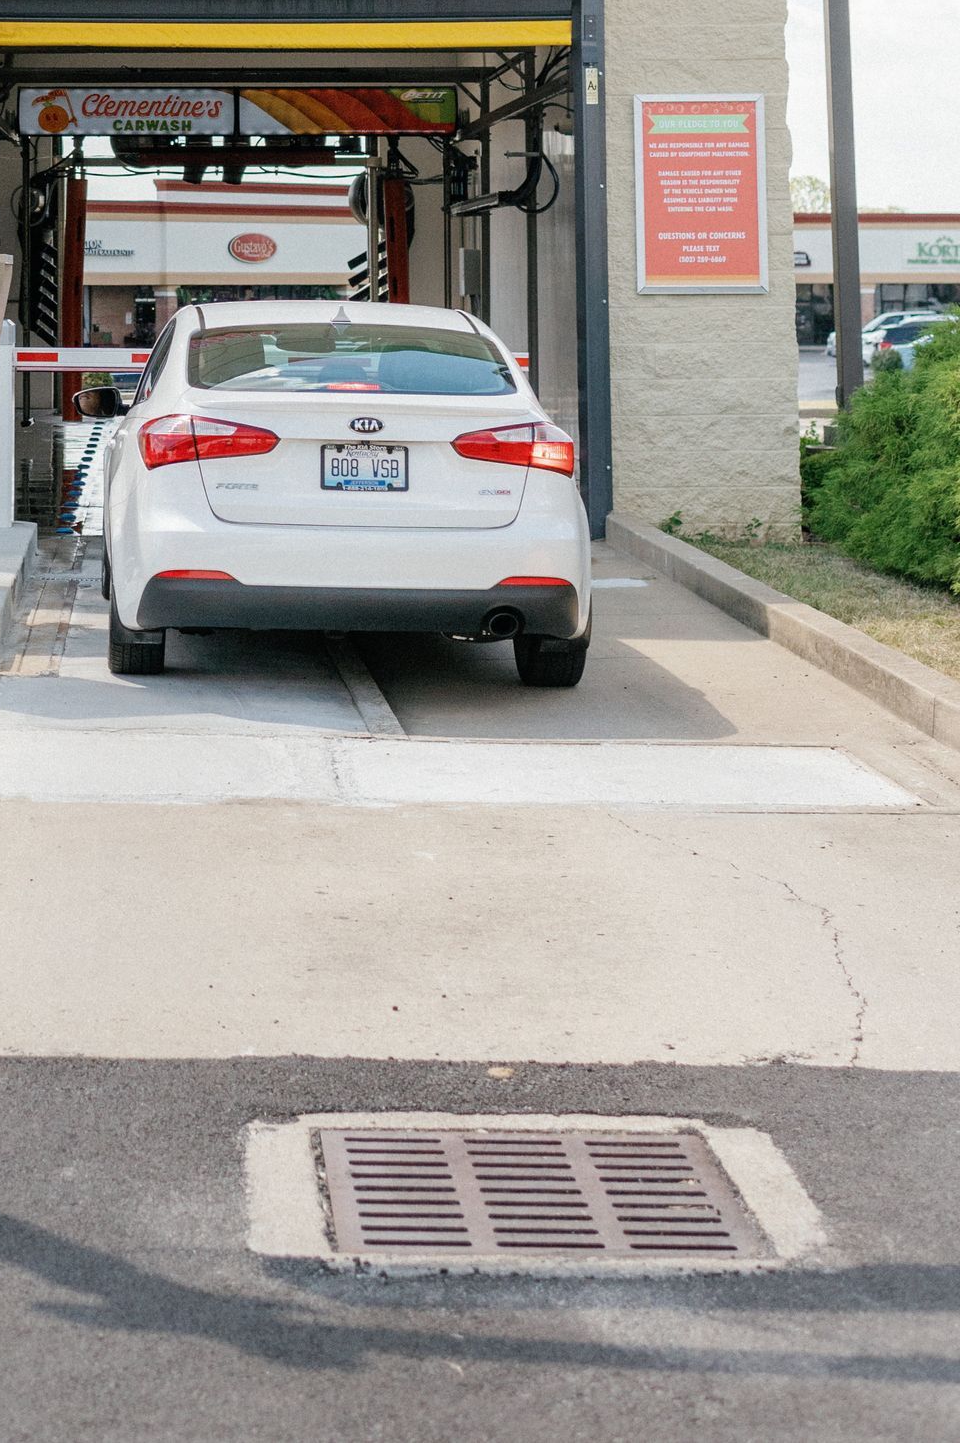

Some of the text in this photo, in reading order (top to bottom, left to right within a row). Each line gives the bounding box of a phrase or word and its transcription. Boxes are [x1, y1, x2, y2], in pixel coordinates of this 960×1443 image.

[81, 93, 223, 118] Clementine's
[112, 119, 192, 132] CARWASH
[724, 119, 739, 129] YOU
[658, 231, 746, 240] QUESTIONS OR CONCERNS
[354, 419, 380, 431] KIA
[345, 449, 379, 458] Kentucky
[331, 457, 399, 478] 808 VSB
